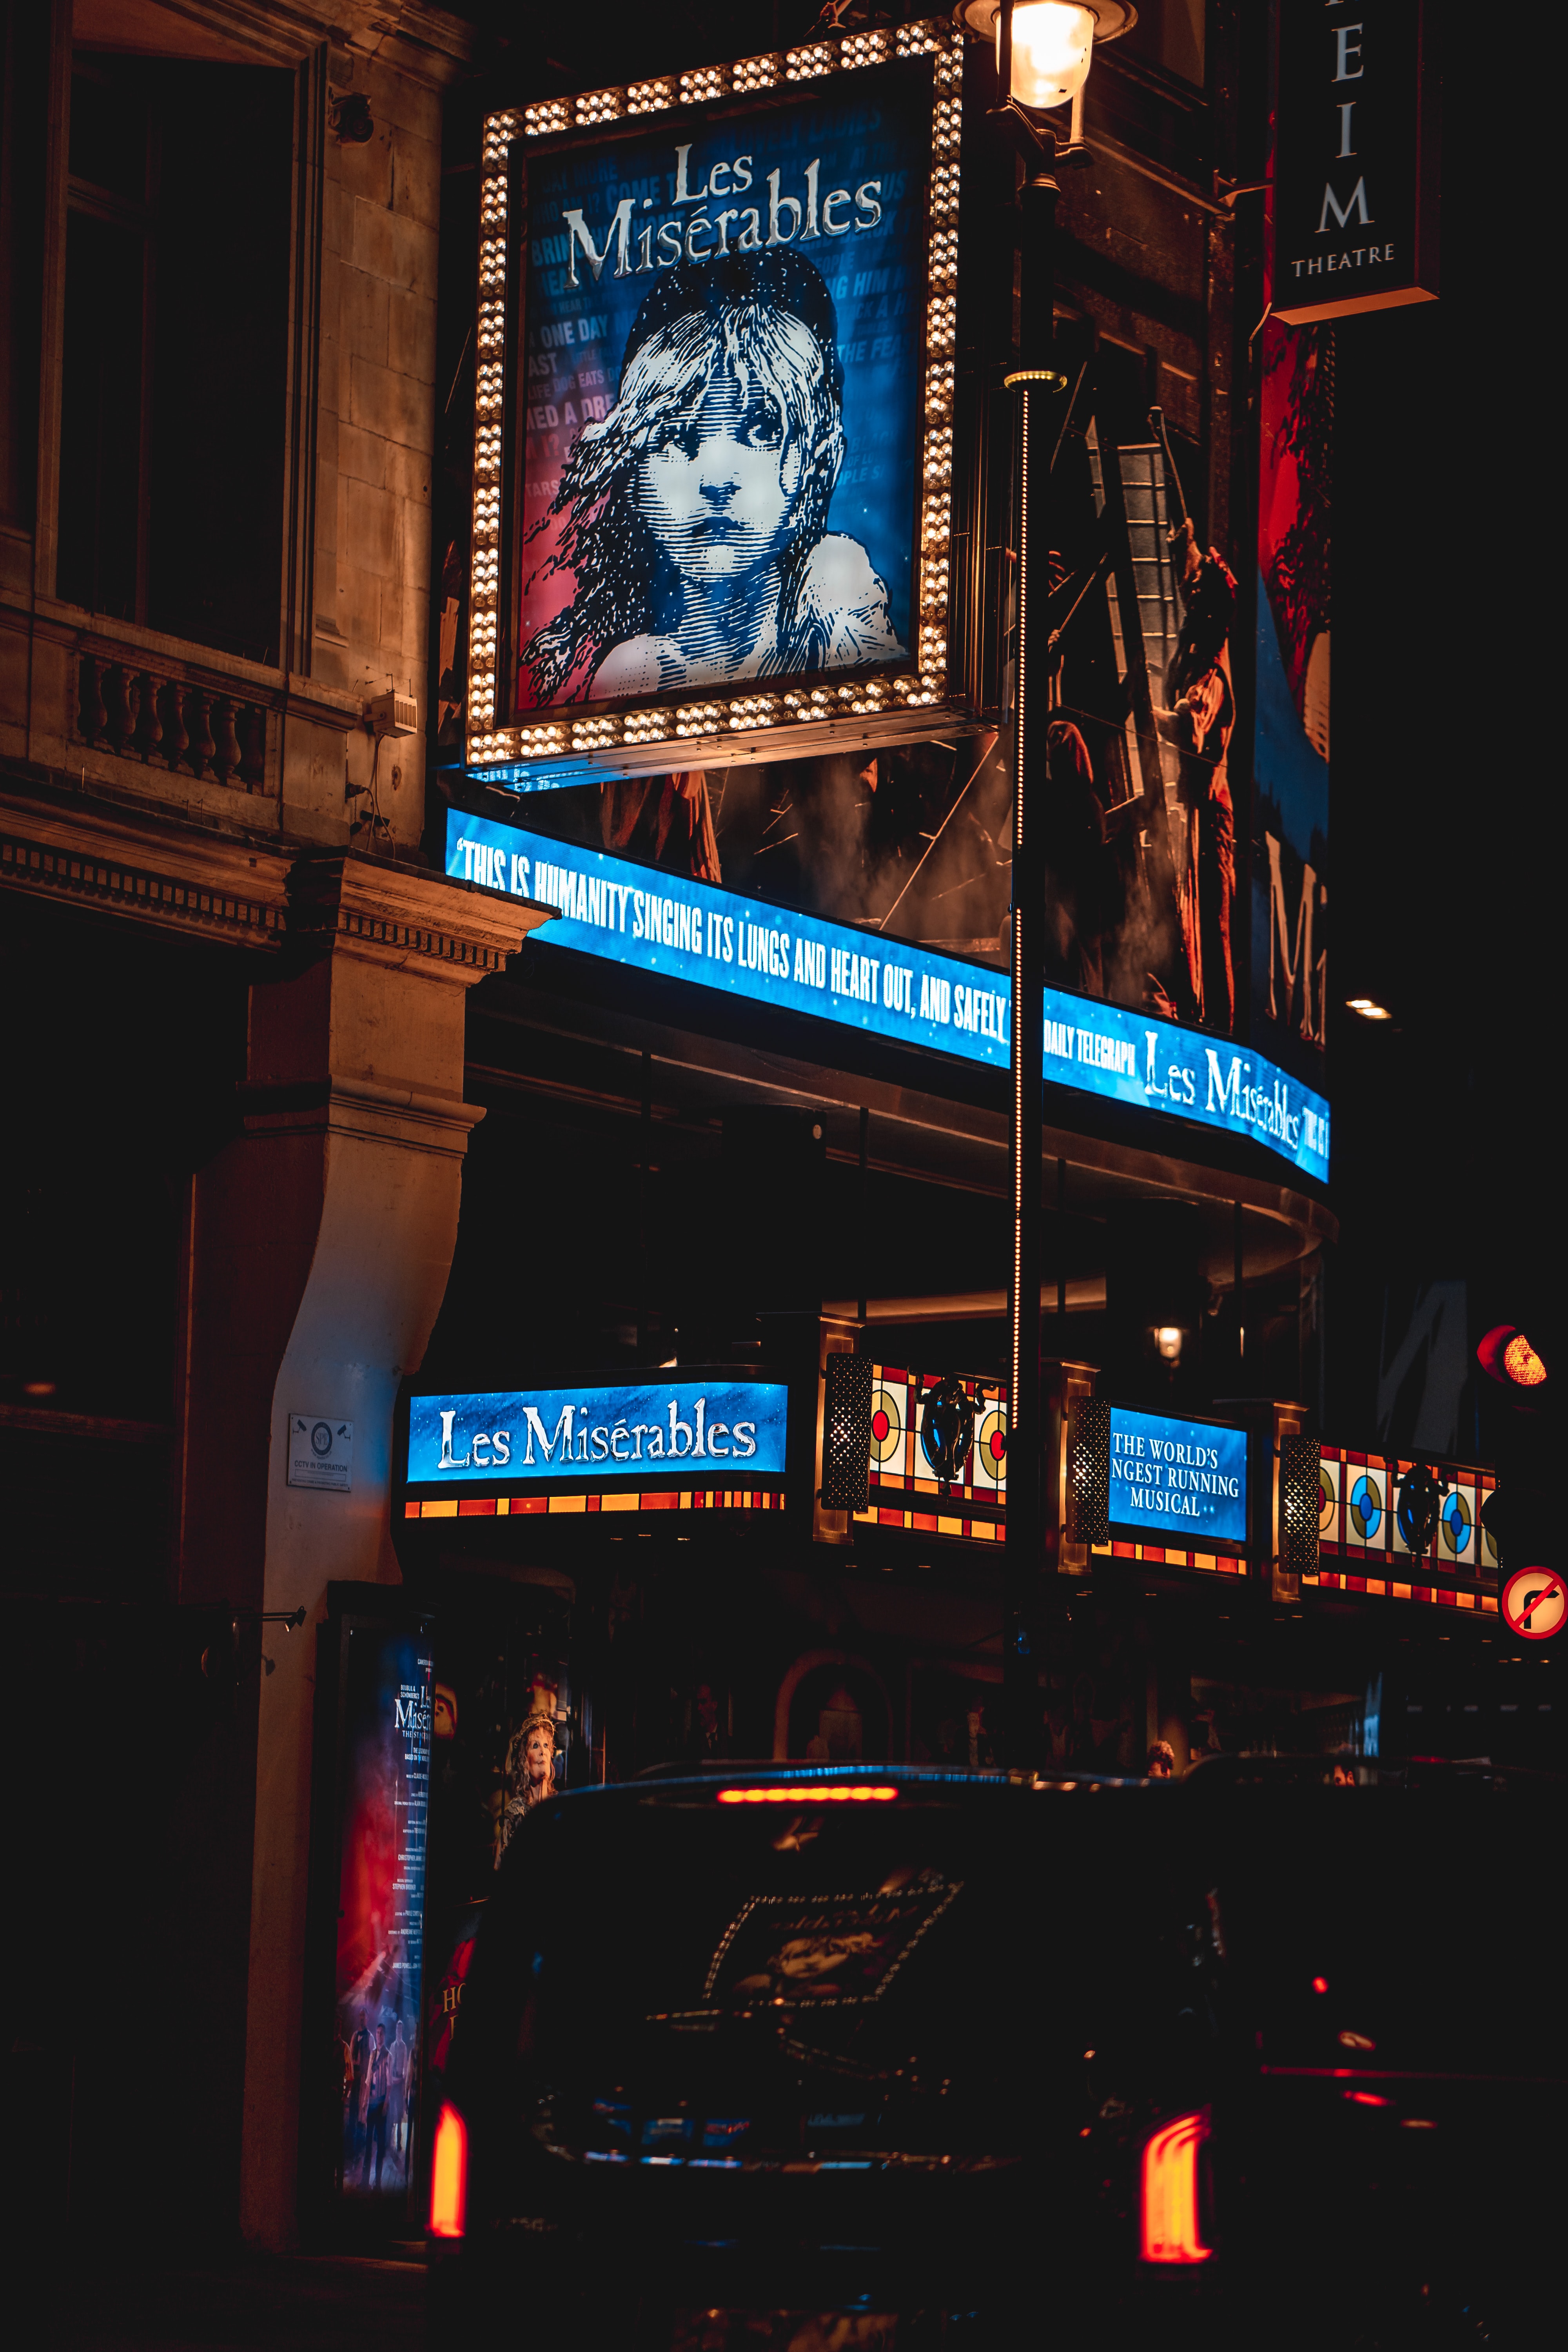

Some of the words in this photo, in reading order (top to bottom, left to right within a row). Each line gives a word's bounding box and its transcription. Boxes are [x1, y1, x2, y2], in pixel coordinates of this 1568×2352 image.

[1314, 0, 1375, 233] EIM
[671, 143, 755, 207] Les
[562, 158, 884, 290] Misérables
[1291, 243, 1395, 277] THEATRE
[852, 267, 889, 297] HIM
[540, 321, 575, 348] ONE
[578, 314, 608, 342] DAY
[837, 340, 867, 363] THE
[552, 375, 575, 392] DOG
[578, 370, 604, 388] EATS
[564, 401, 577, 425] A
[510, 853, 530, 898] IS
[534, 860, 631, 933] HUMANITY
[632, 889, 702, 955] SINGING
[707, 912, 733, 963] ITS
[738, 920, 790, 979] LUNGS
[793, 938, 826, 989] AND
[830, 947, 881, 1004] HEART
[883, 963, 916, 1019] OUT,
[919, 974, 951, 1024] AND
[1044, 1019, 1075, 1060] DAILY
[1076, 1028, 1136, 1077] TELEGRAPH
[1145, 1031, 1196, 1105] Les
[1205, 1048, 1299, 1150] Misérables
[437, 1410, 510, 1469] Les
[522, 1397, 756, 1465] Misérables
[294, 1460, 309, 1468] CCTV
[317, 1463, 347, 1472] OPERATION
[1112, 1432, 1145, 1457] THE
[1149, 1438, 1218, 1469] WORLD’S
[1111, 1458, 1163, 1485] NGEST
[1168, 1467, 1240, 1498] RUNNING
[1130, 1486, 1200, 1517] MUSICAL
